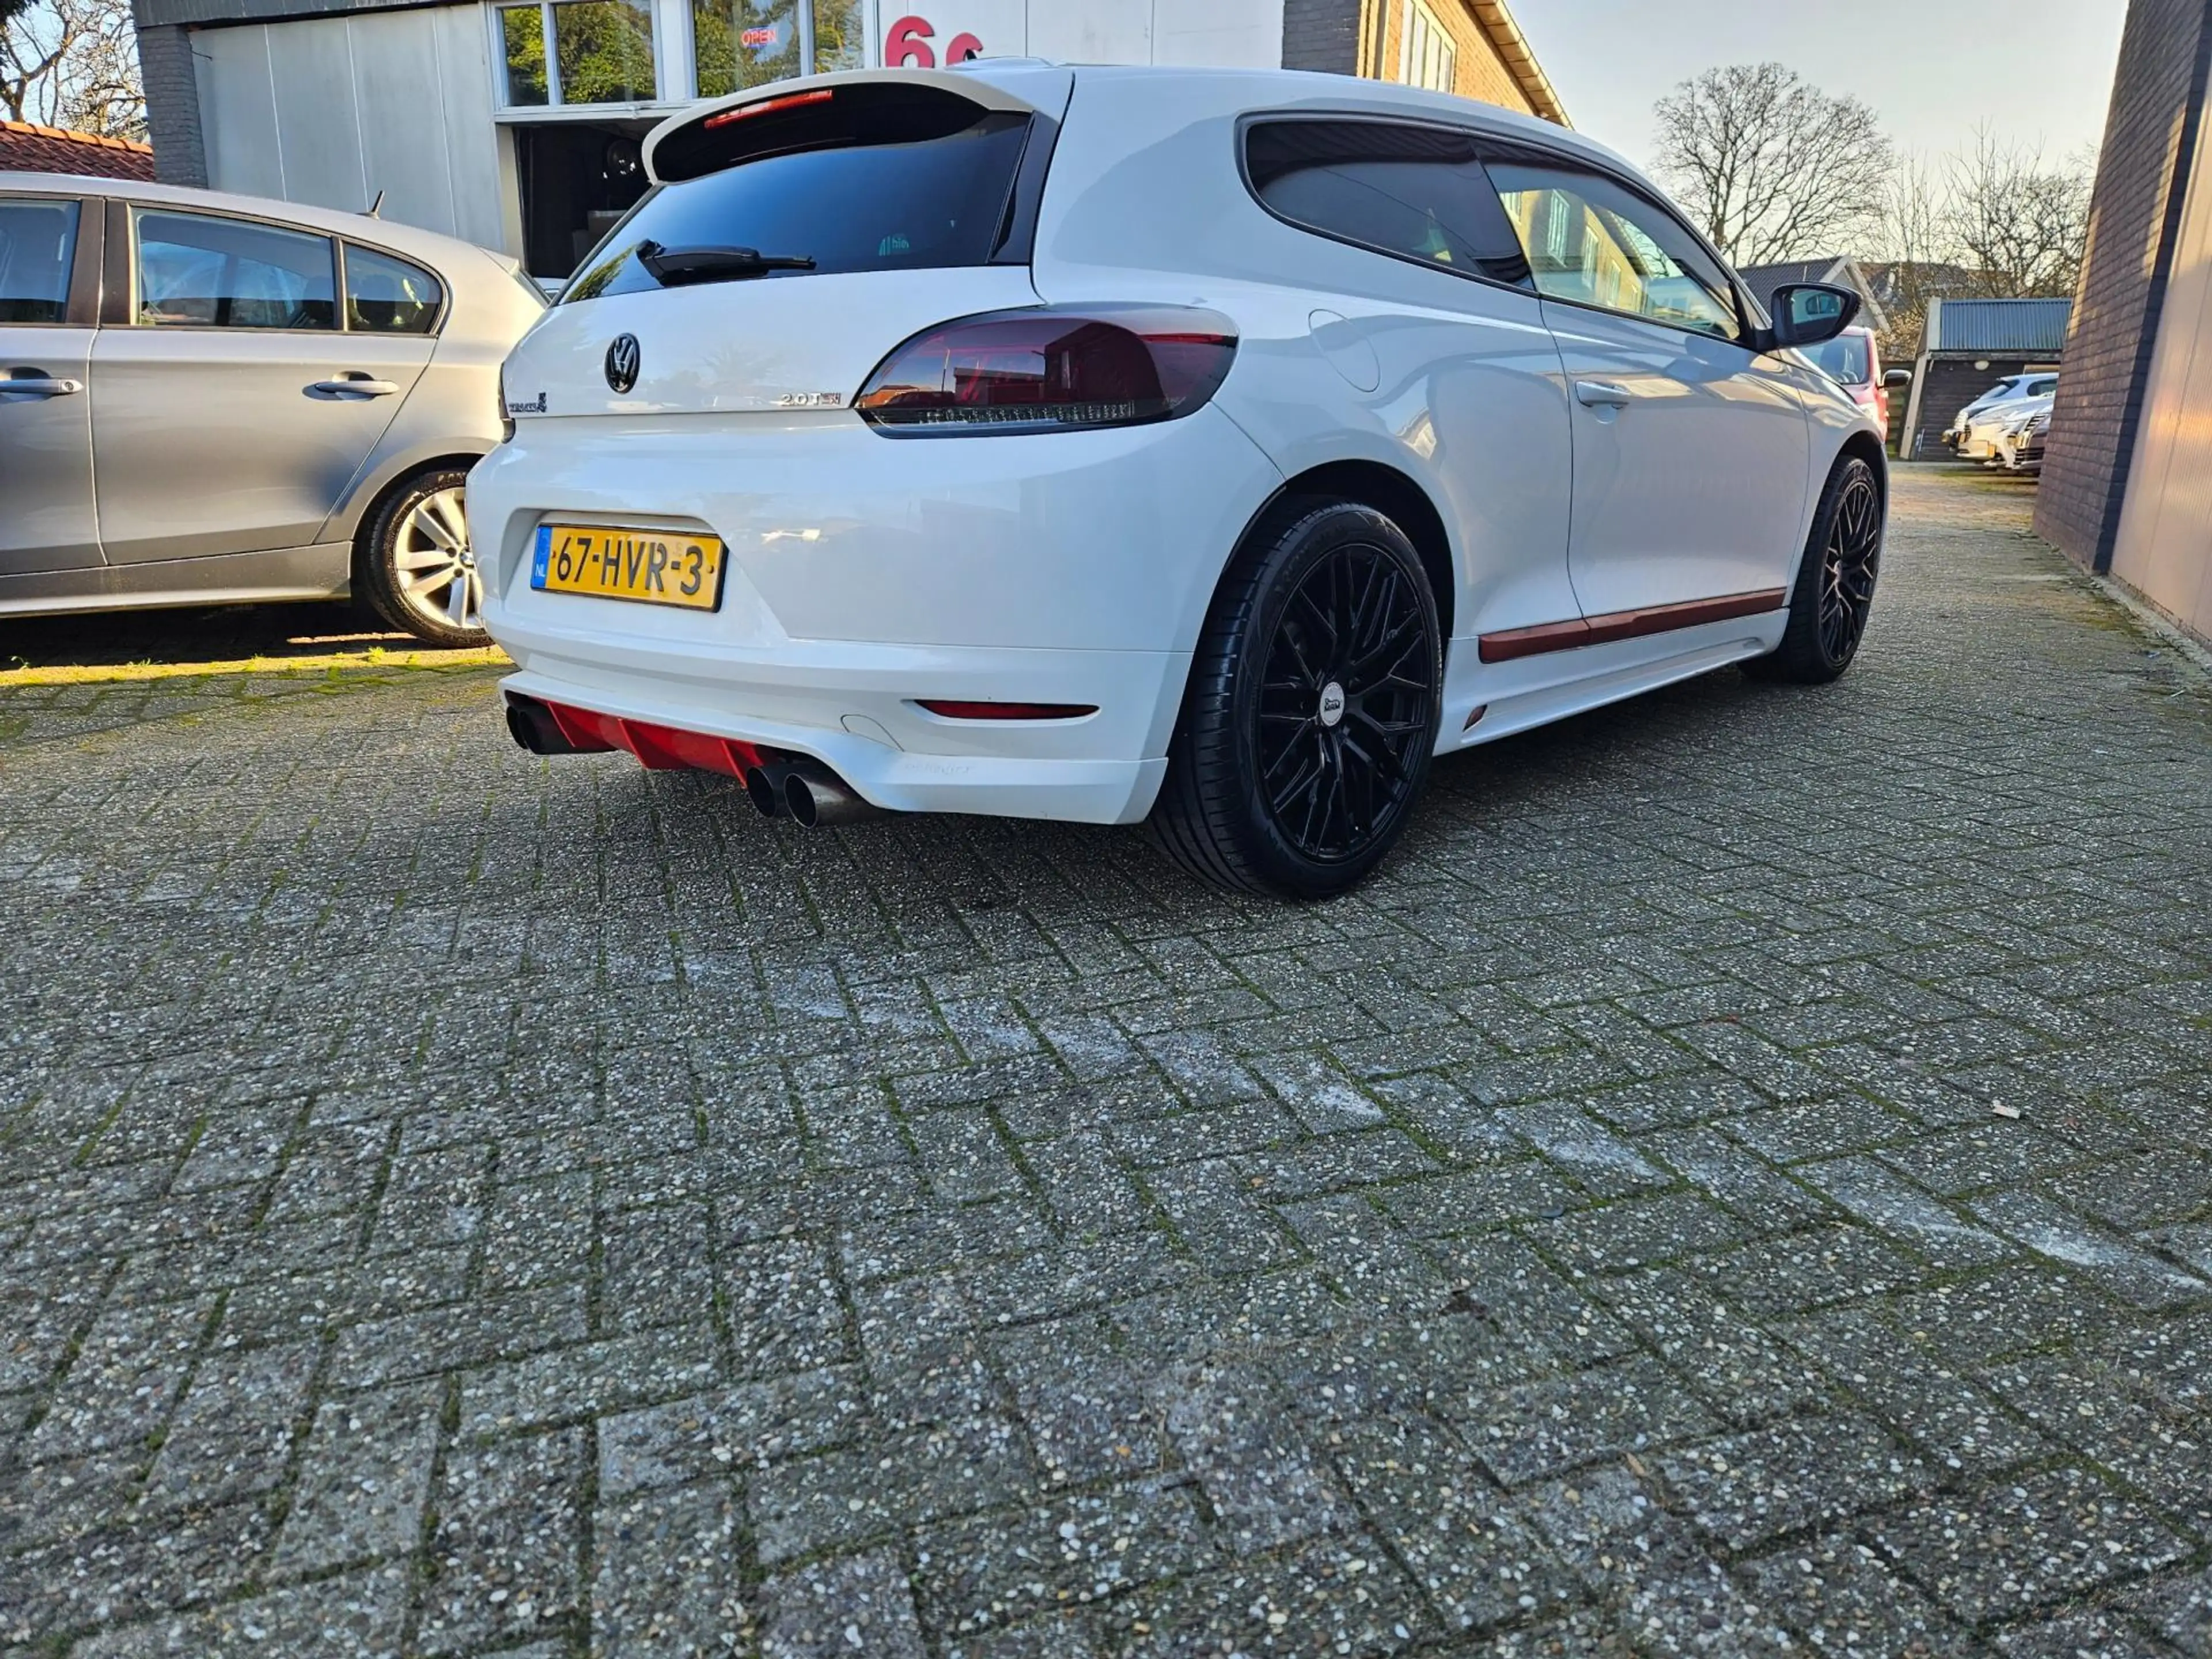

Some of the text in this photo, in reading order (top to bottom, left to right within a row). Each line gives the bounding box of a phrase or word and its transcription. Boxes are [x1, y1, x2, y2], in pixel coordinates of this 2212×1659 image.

[741, 29, 777, 47] OPEN
[535, 563, 546, 577] NL
[556, 536, 703, 596] 67-HVR-3
